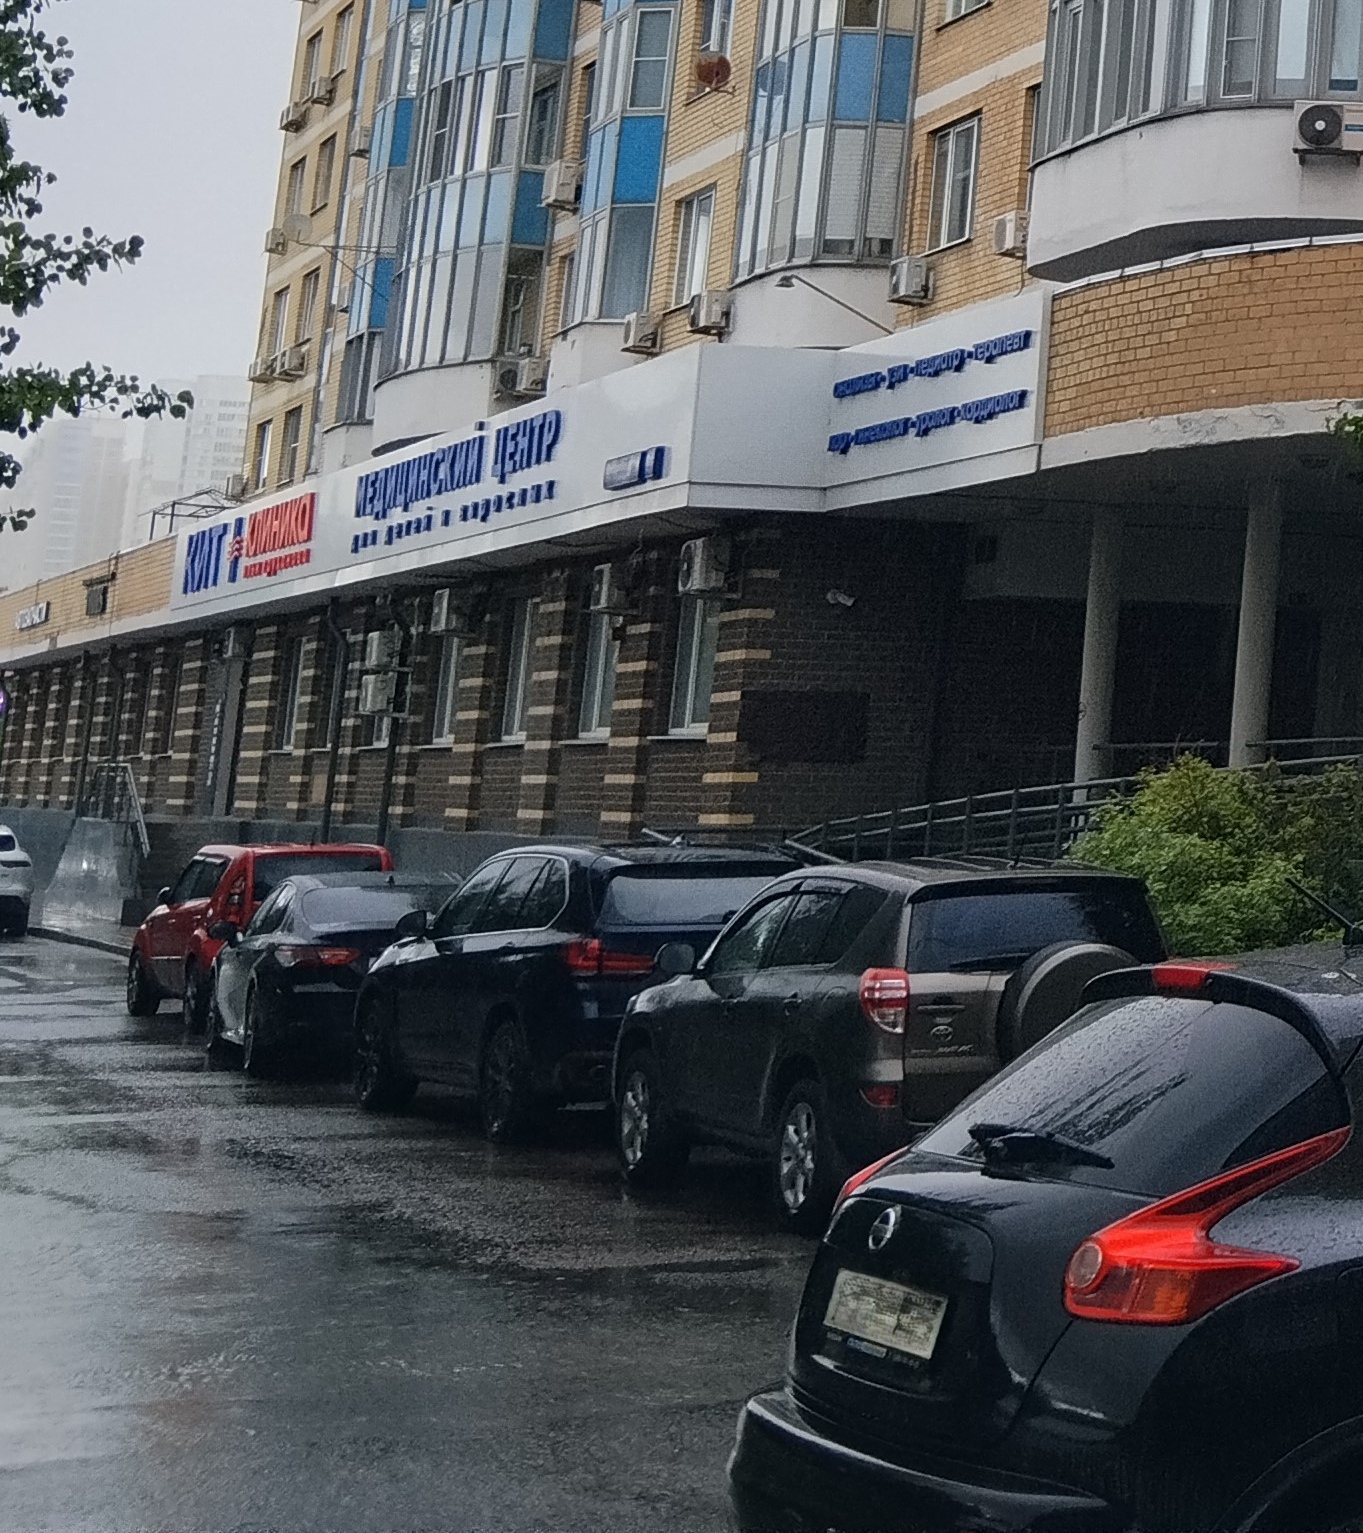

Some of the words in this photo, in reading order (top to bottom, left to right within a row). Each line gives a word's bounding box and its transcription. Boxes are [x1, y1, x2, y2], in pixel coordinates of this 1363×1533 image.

[972, 329, 1033, 364] терапевт
[960, 389, 1029, 425] кардиолог
[491, 409, 563, 485] ЦЕНТР
